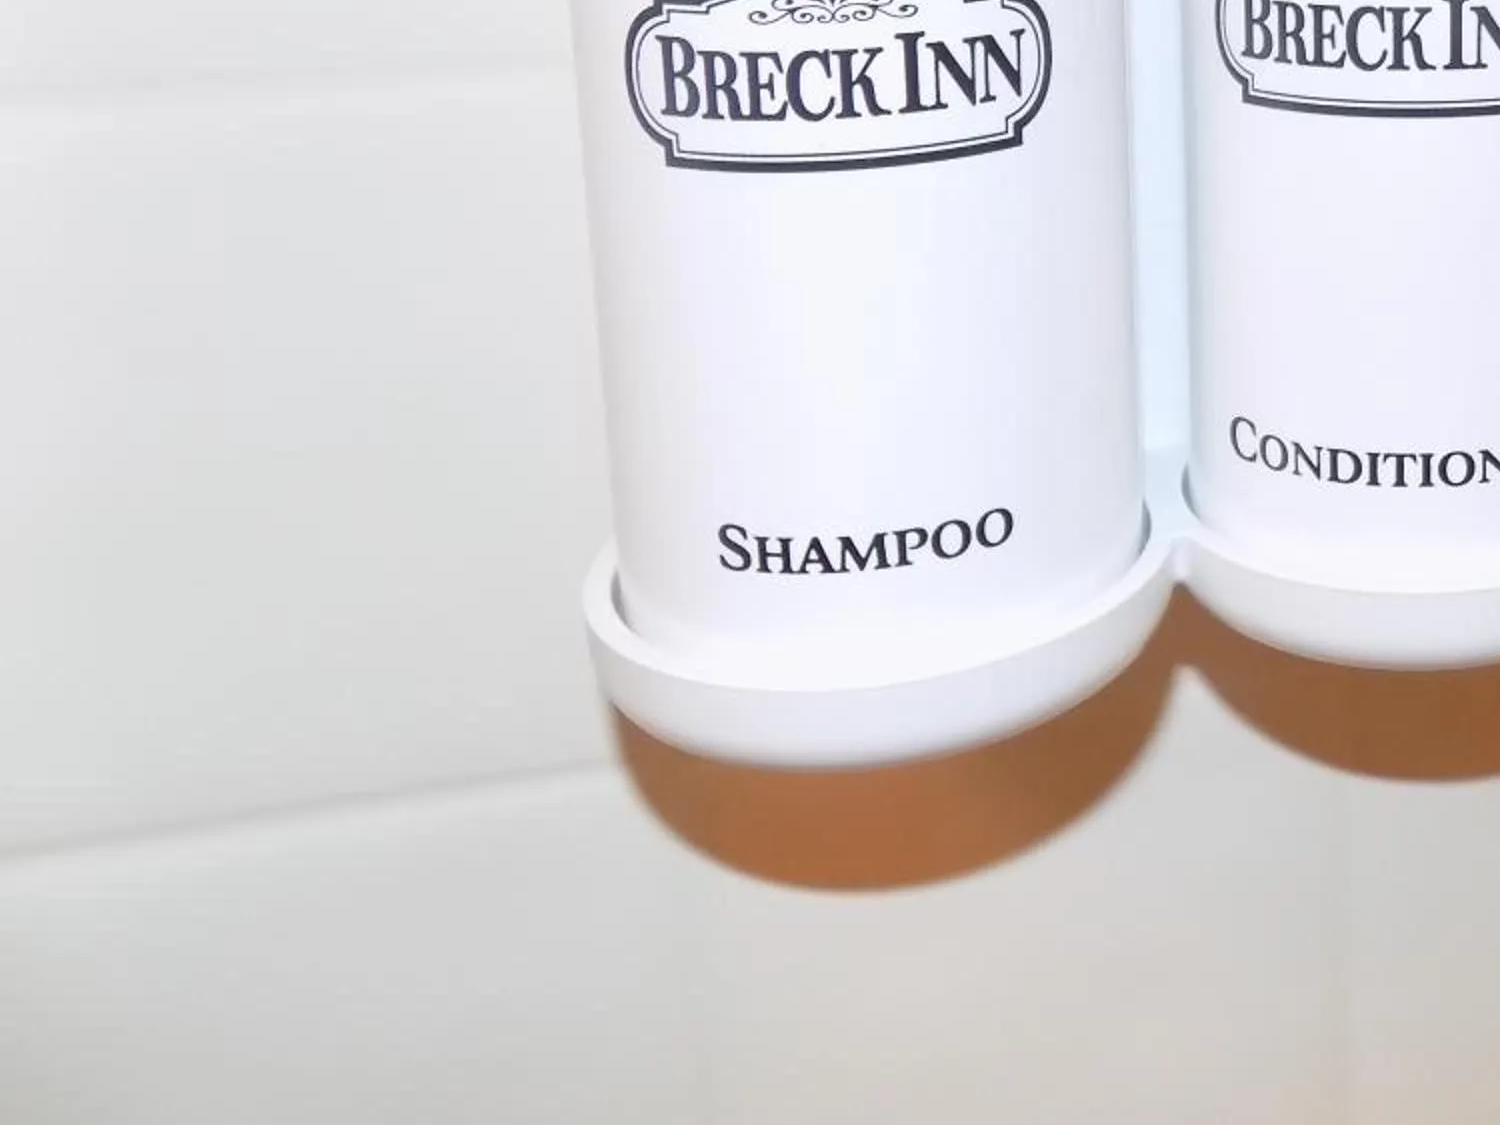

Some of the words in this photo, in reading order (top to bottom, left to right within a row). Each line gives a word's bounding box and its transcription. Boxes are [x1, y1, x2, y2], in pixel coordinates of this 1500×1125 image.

[656, 35, 893, 122] BRECK
[895, 29, 1026, 114] INN
[718, 508, 1014, 575] SHAMPOO
